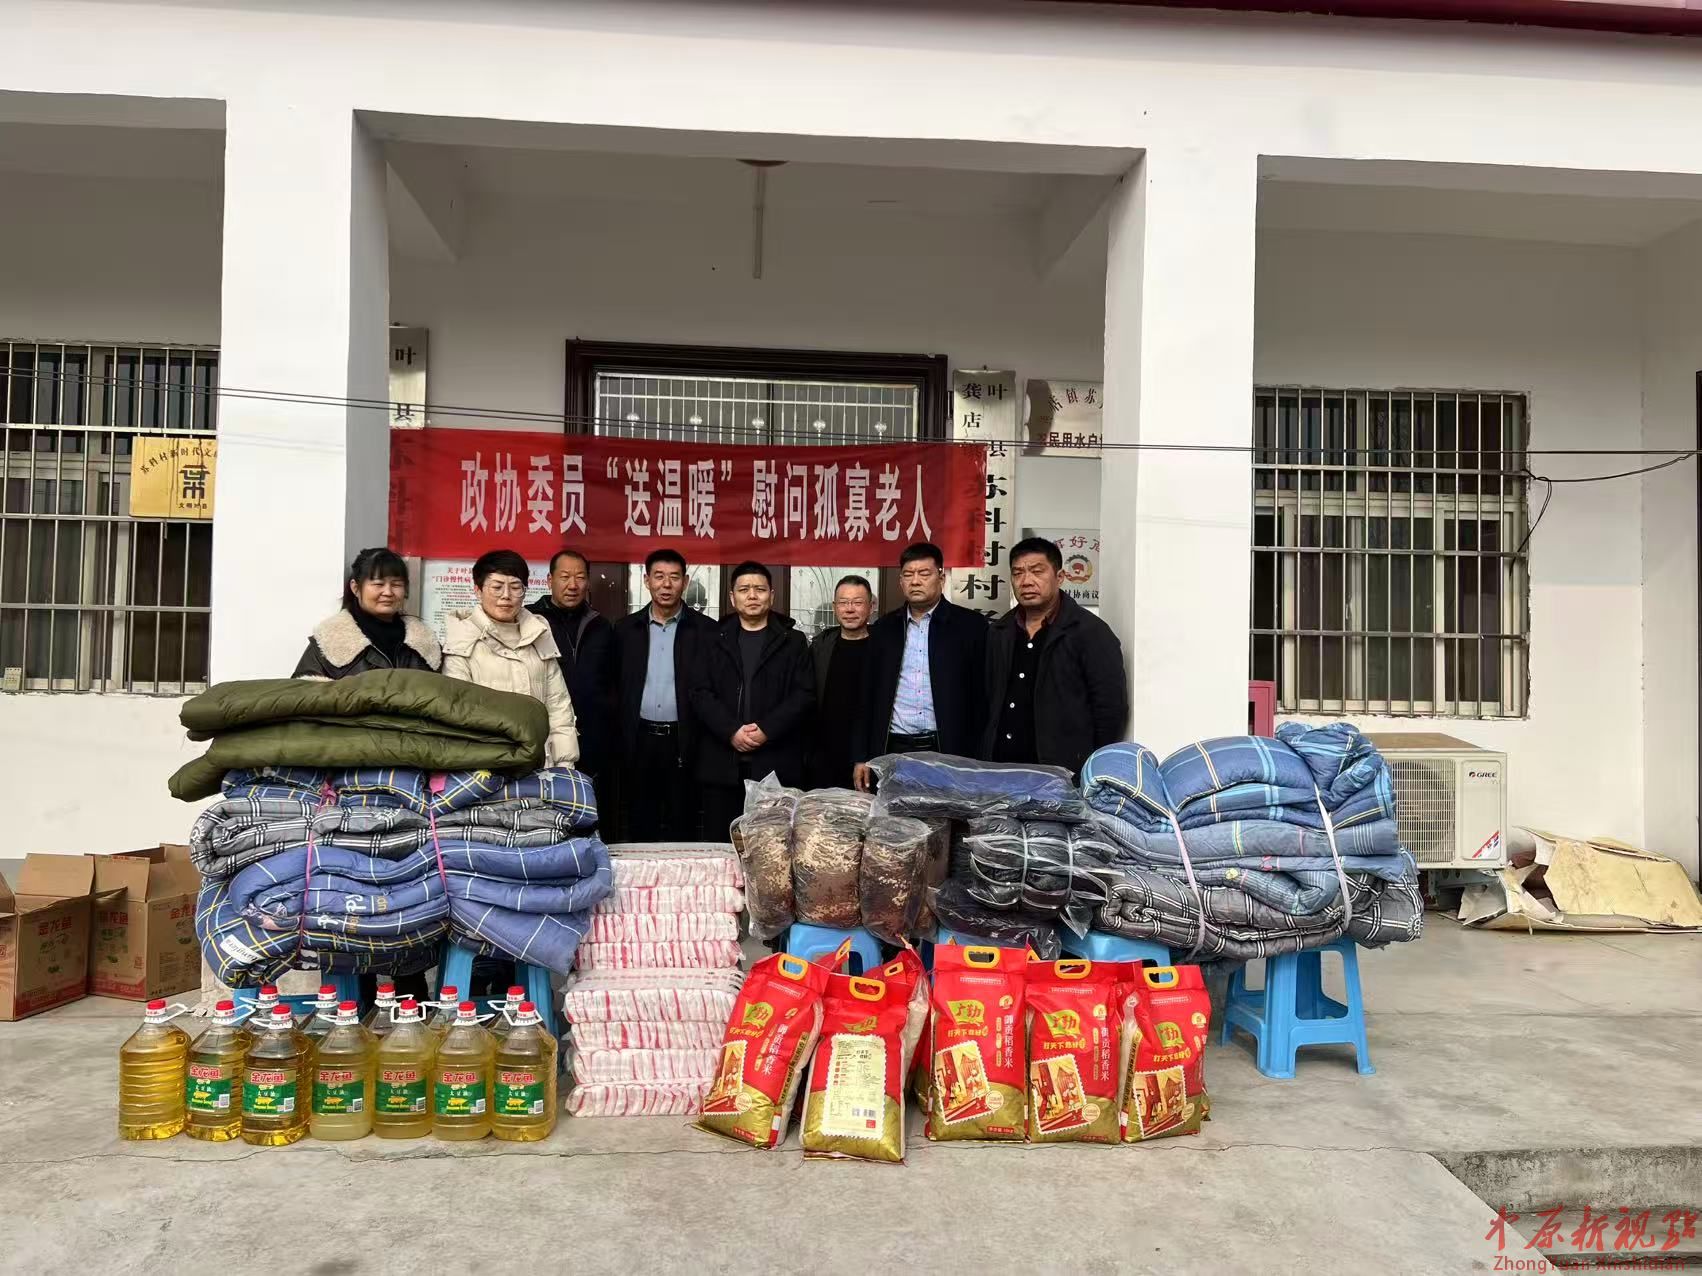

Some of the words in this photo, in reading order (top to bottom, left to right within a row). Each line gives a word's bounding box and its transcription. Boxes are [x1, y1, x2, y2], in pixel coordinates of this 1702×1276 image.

[393, 346, 416, 422] 叶县
[962, 383, 982, 437] 龚店
[988, 384, 1008, 457] 叶县
[460, 452, 586, 535] 政协委员
[607, 457, 732, 538] “送温暖”
[751, 460, 932, 541] 慰问孤寡老人
